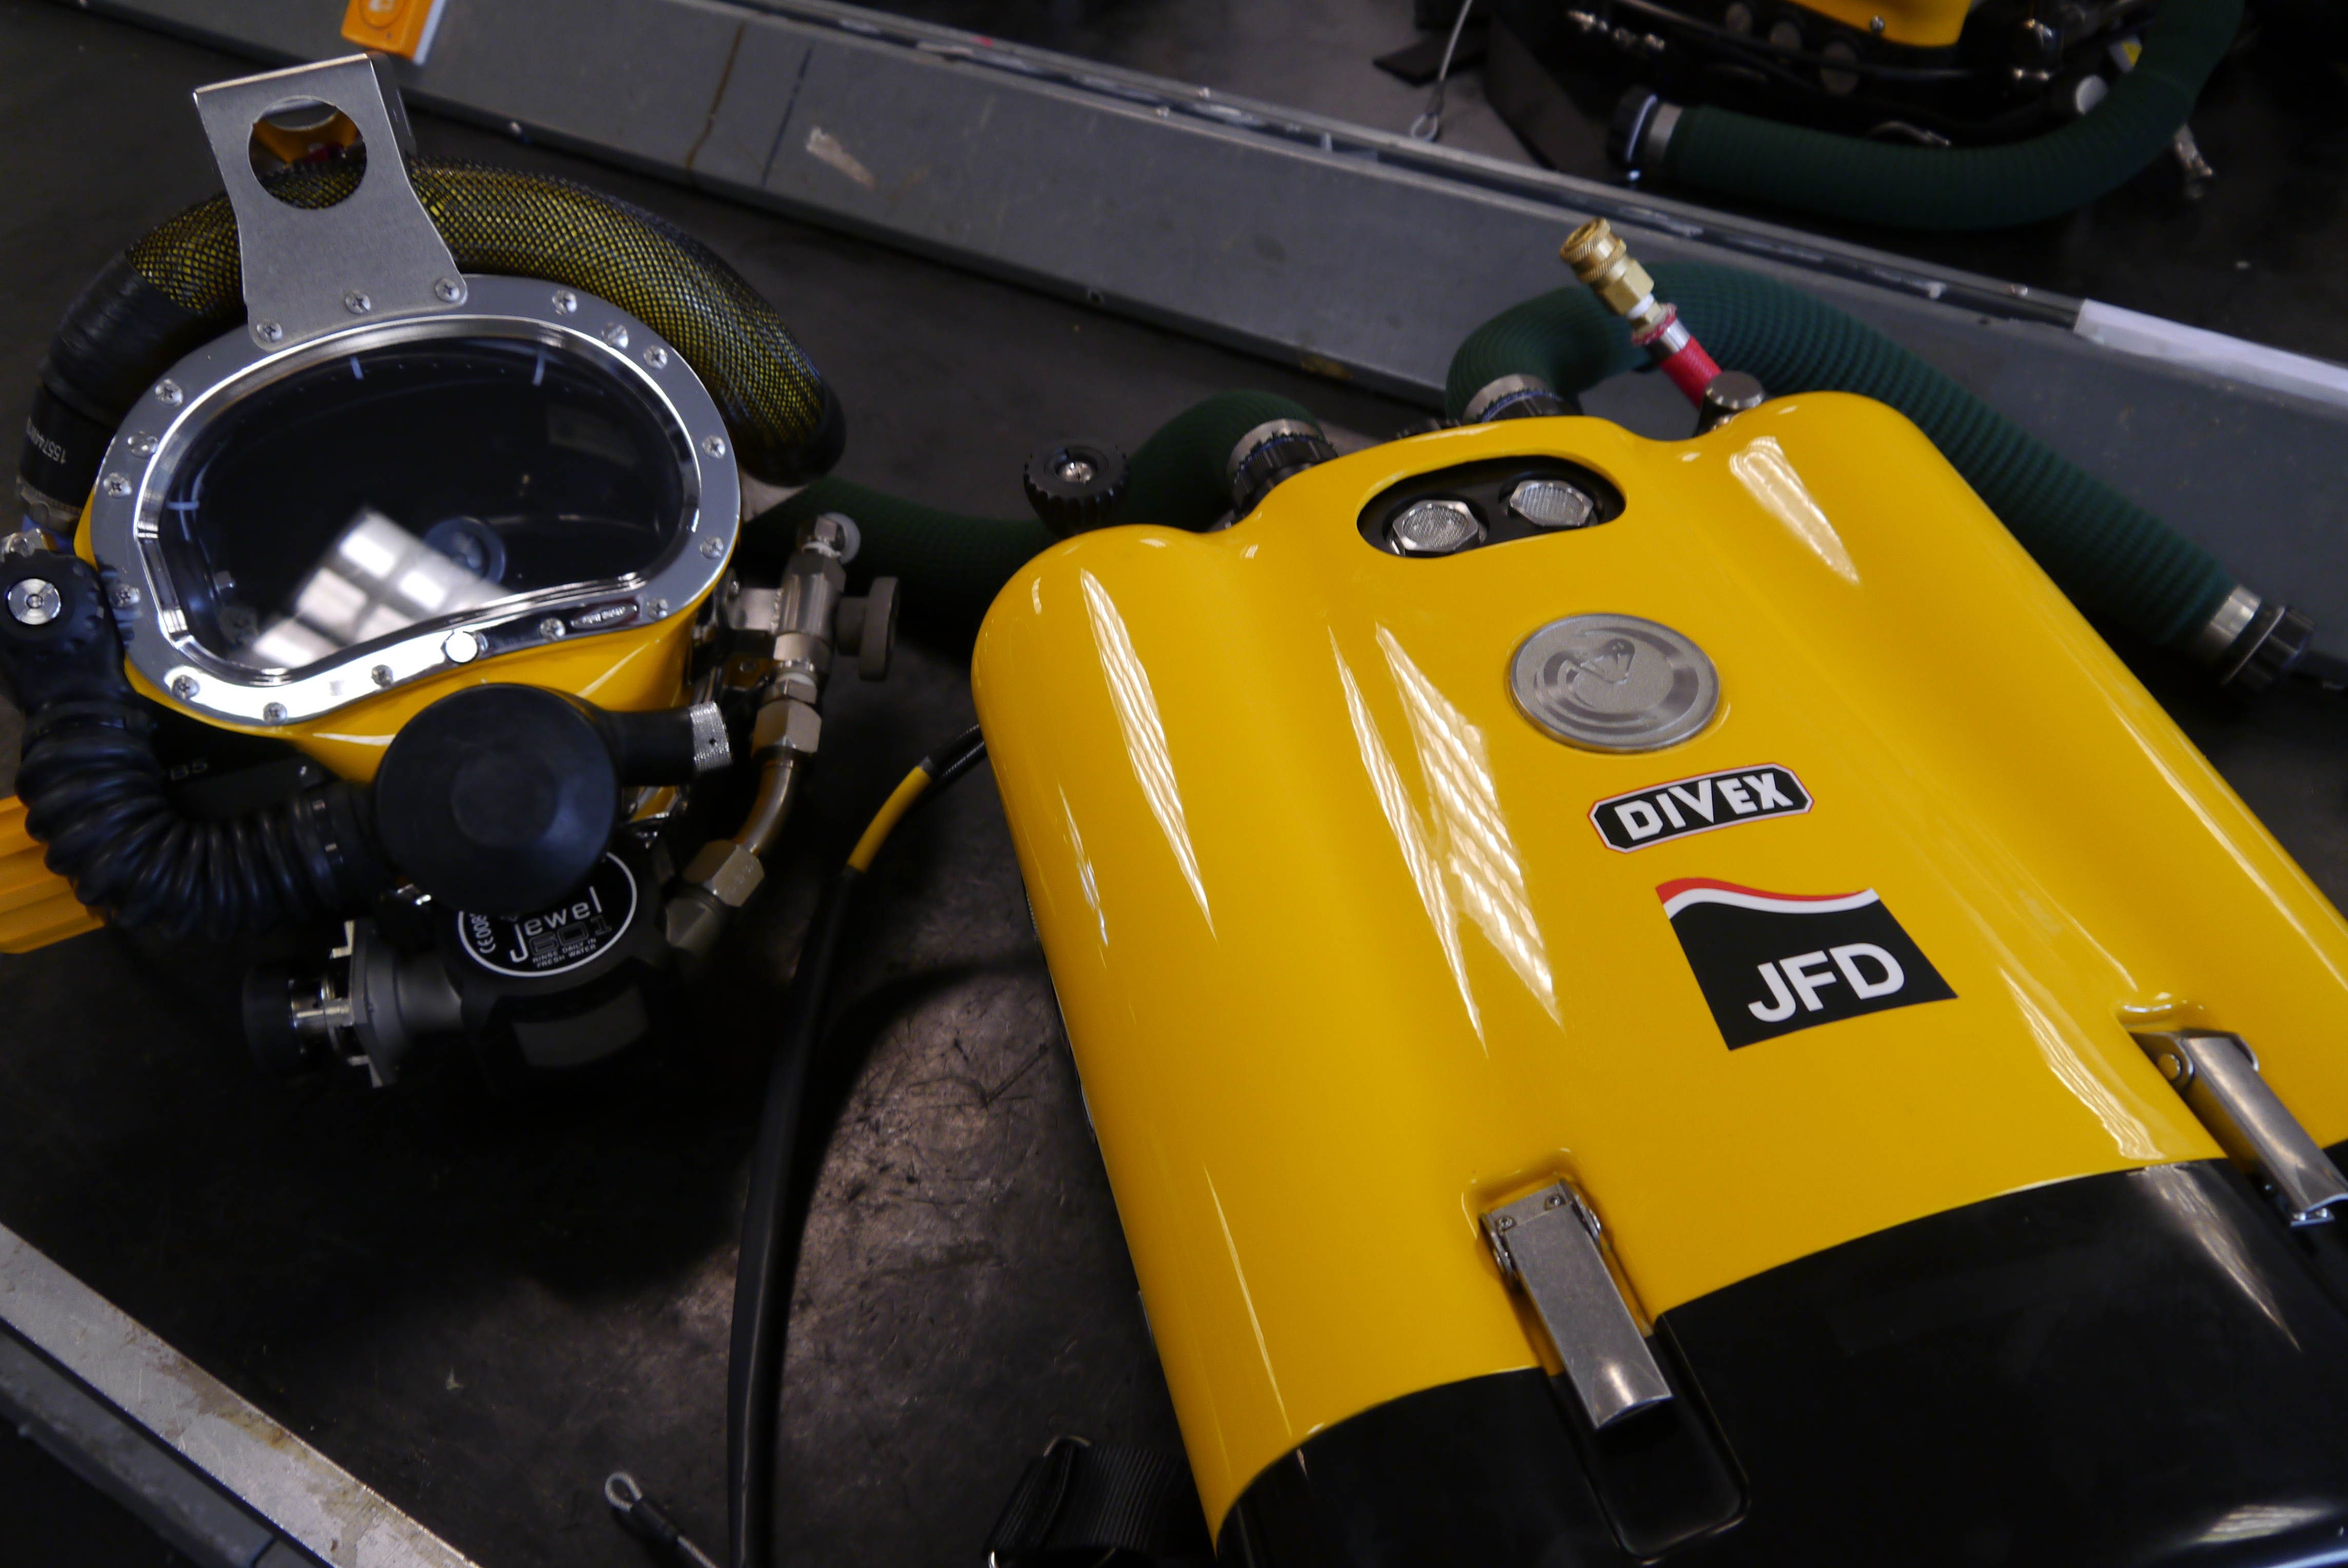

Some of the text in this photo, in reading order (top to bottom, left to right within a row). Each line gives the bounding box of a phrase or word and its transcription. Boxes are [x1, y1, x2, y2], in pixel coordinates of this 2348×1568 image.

[1614, 772, 1794, 841] DIVEX
[532, 937, 597, 964] RINSE DAILY IN
[536, 944, 597, 969] FRESH WATER
[1747, 943, 1905, 1023] JFD
